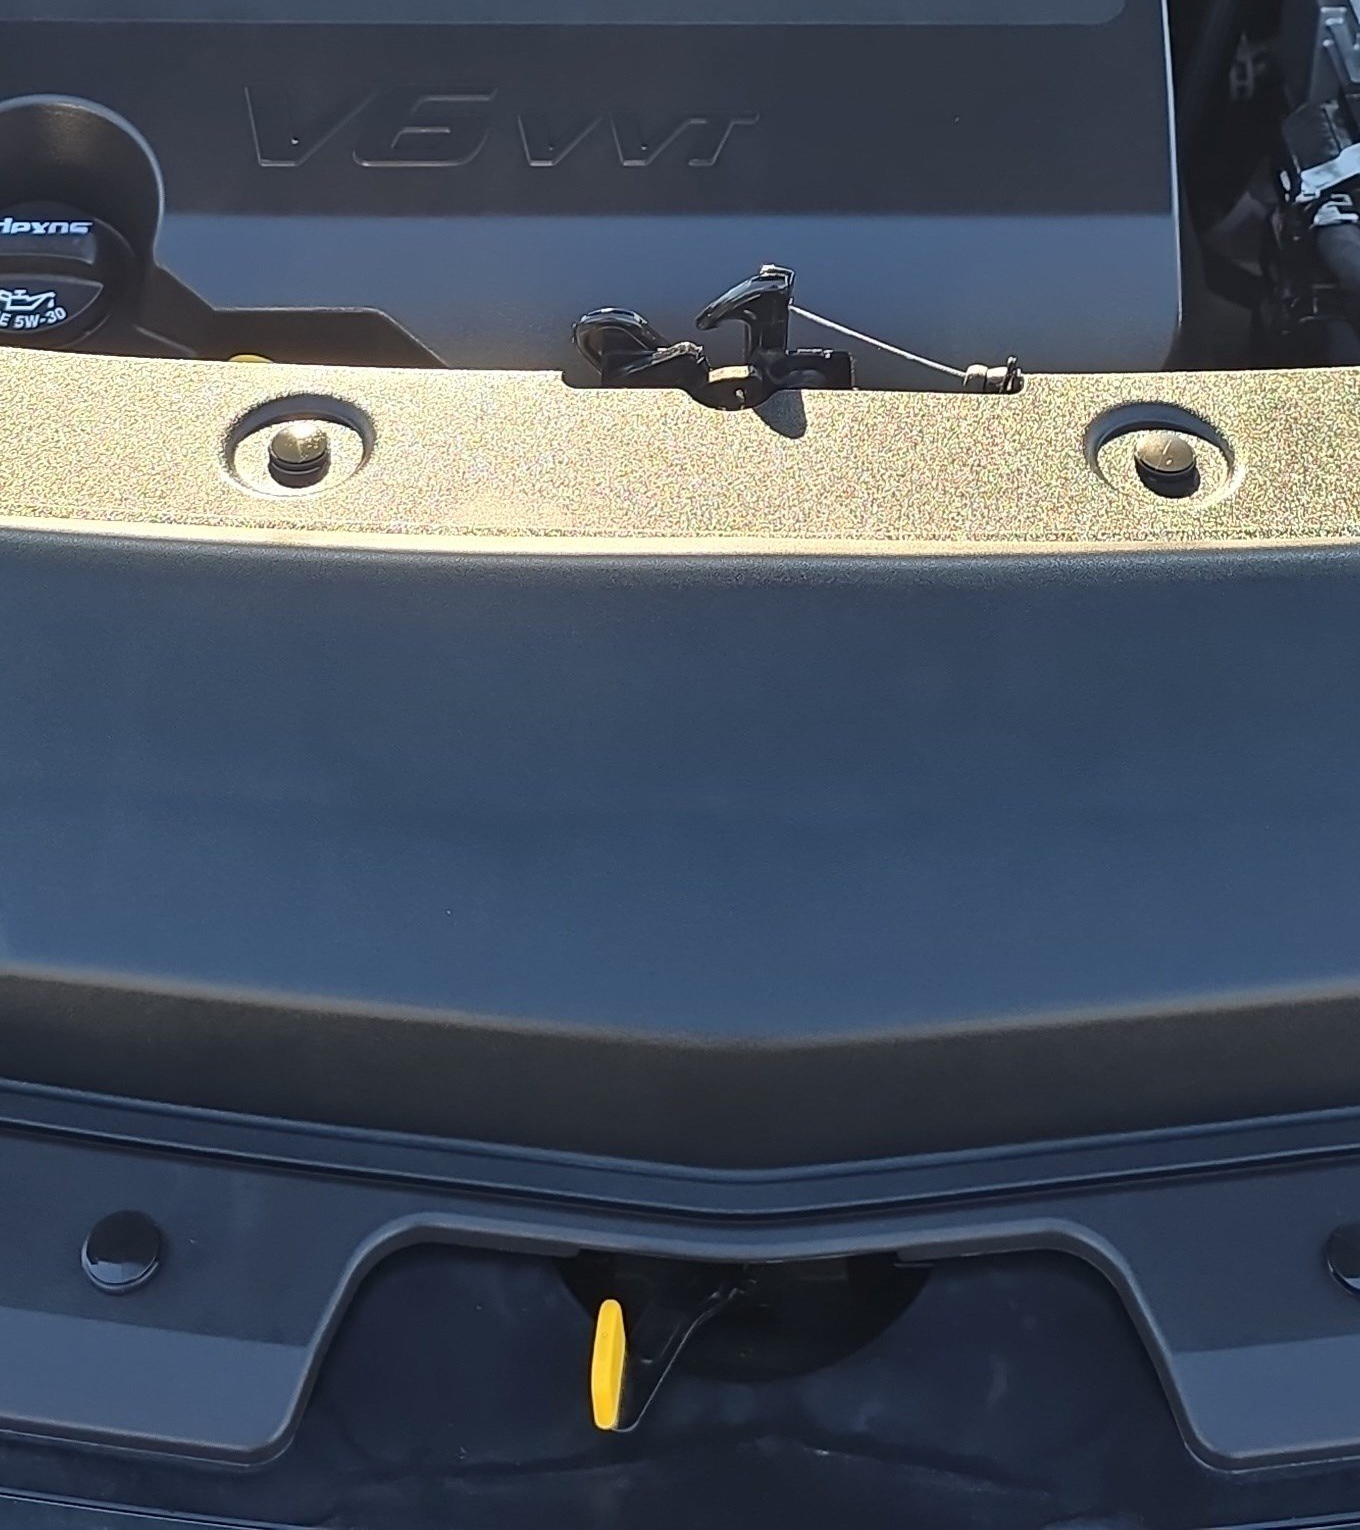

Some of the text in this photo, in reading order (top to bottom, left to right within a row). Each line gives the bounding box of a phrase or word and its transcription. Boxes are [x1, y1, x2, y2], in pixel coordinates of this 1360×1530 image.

[244, 86, 760, 167] V6 VVT
[13, 306, 68, 330] 5W-30
